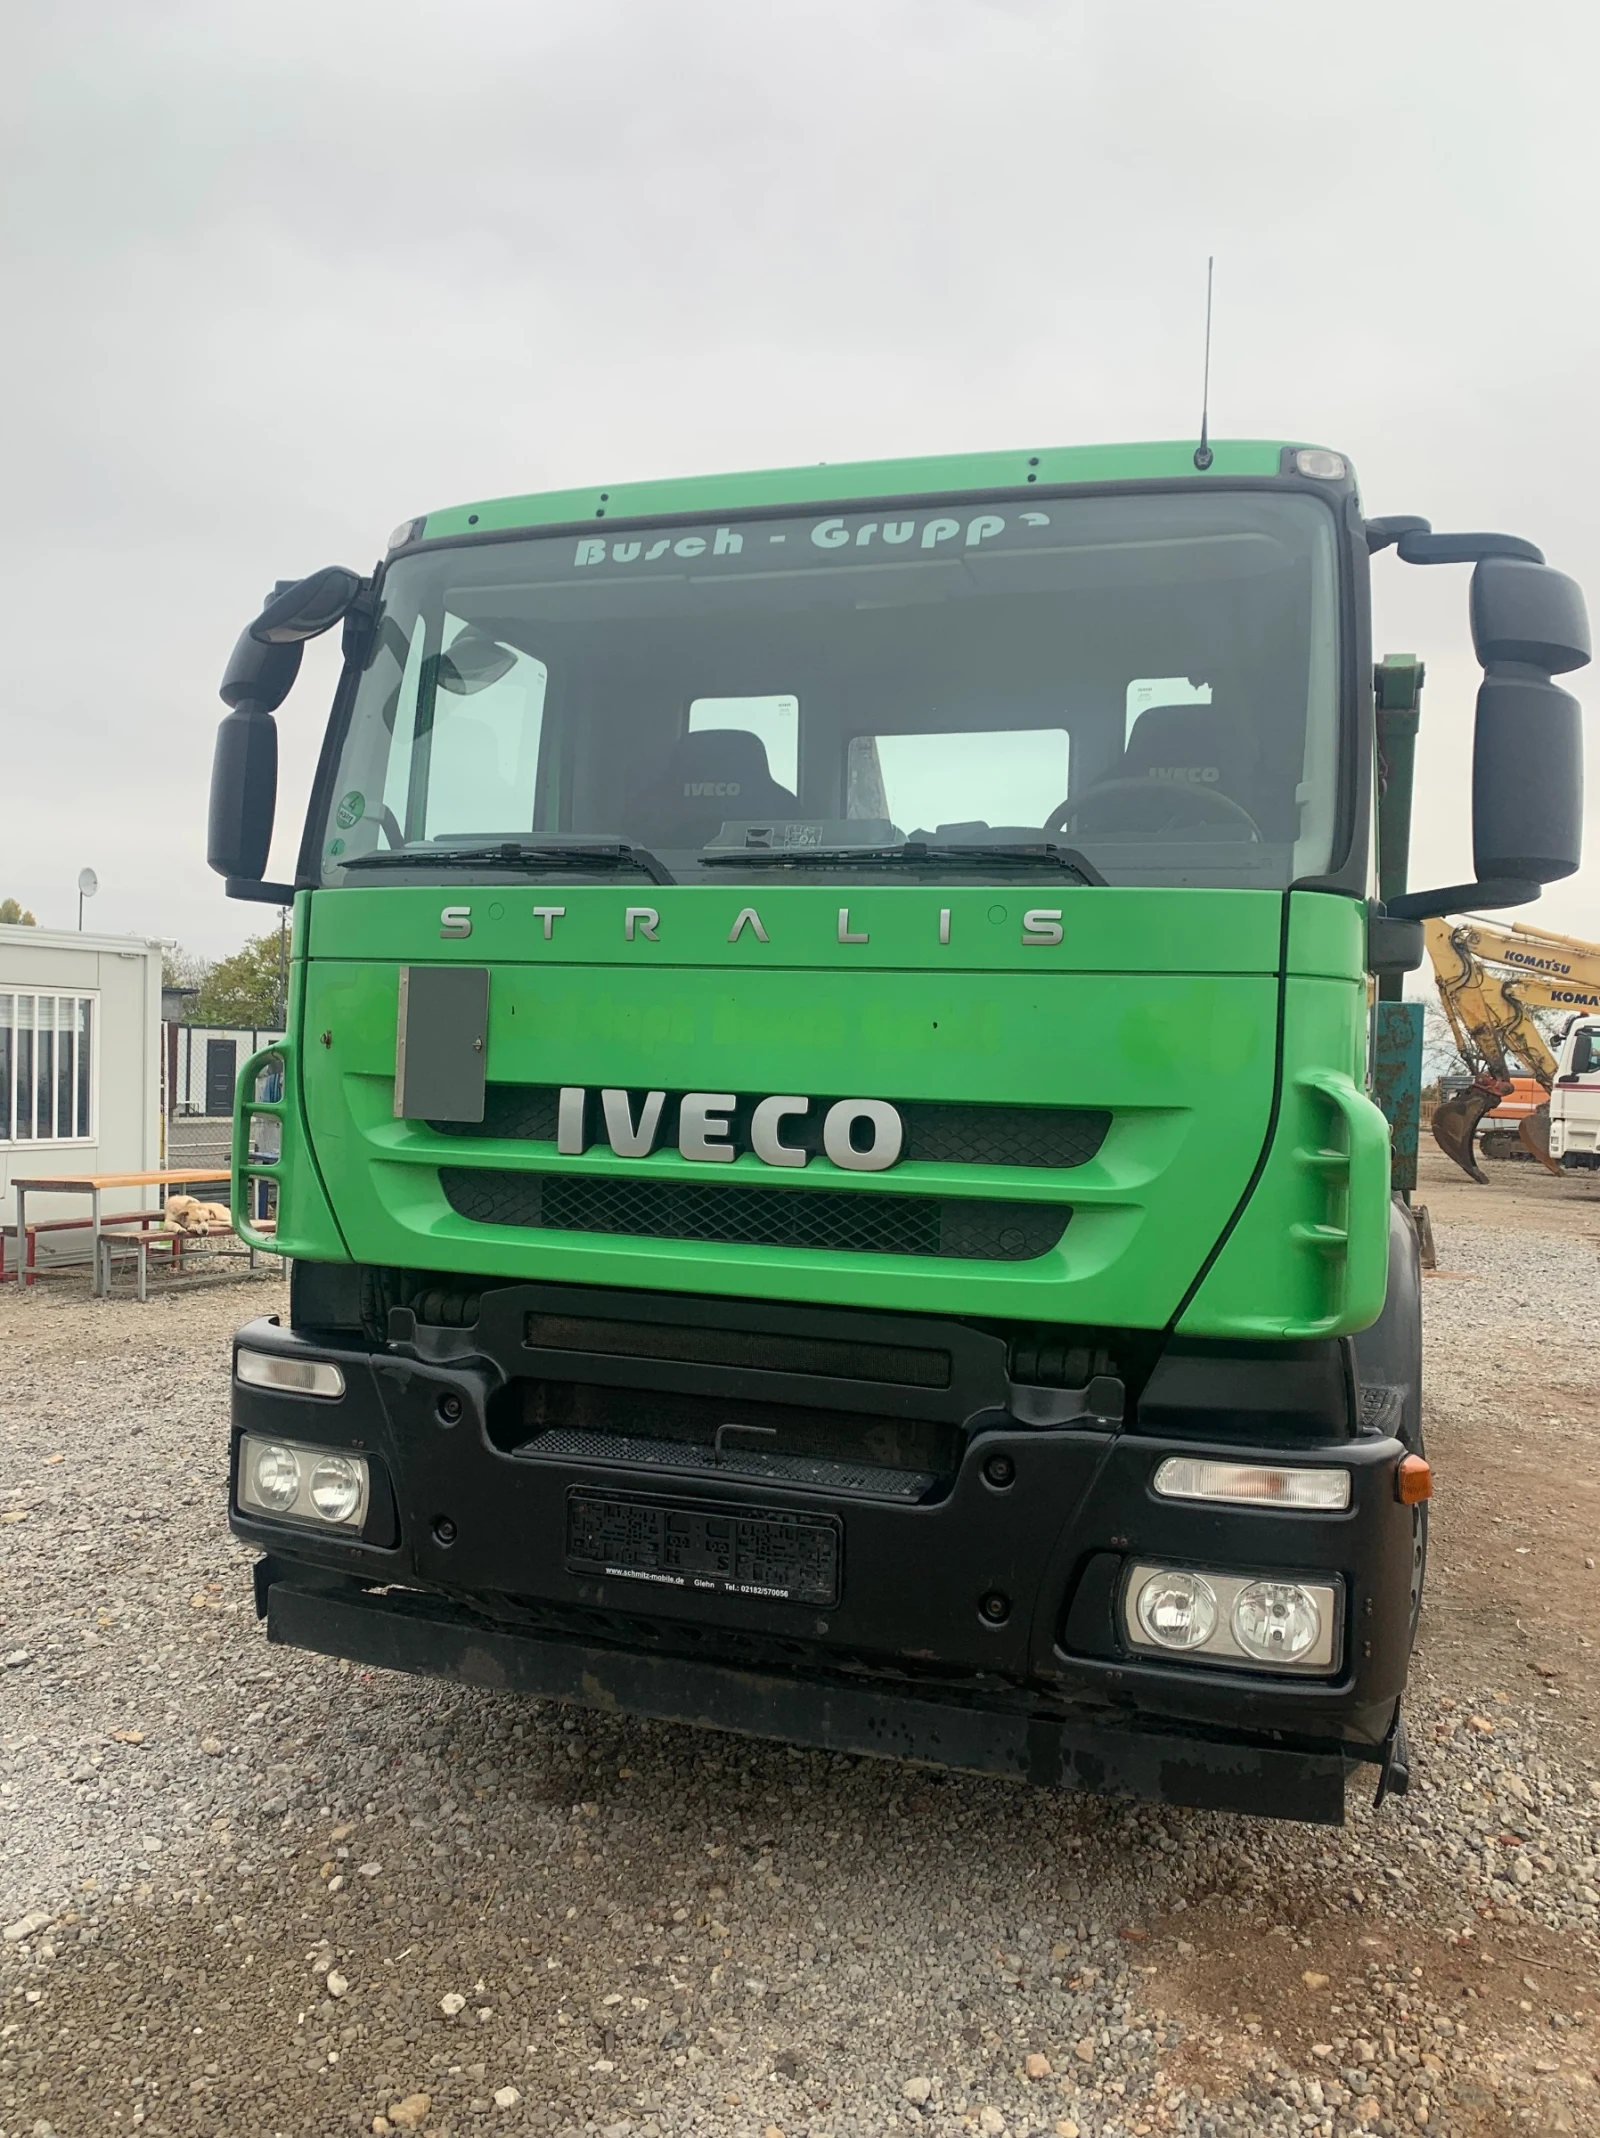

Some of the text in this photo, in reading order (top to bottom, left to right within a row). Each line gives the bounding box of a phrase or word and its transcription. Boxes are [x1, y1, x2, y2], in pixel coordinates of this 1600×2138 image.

[573, 528, 744, 568] Busch
[1149, 766, 1220, 783] IVECO
[684, 782, 741, 797] IVECO
[439, 906, 1065, 945] STRALIS
[1504, 950, 1571, 975] KOMATSU
[1550, 990, 1600, 1007] KOMA
[557, 1086, 904, 1172] IVECO
[605, 1567, 685, 1586] www.schmitz-mobile.de
